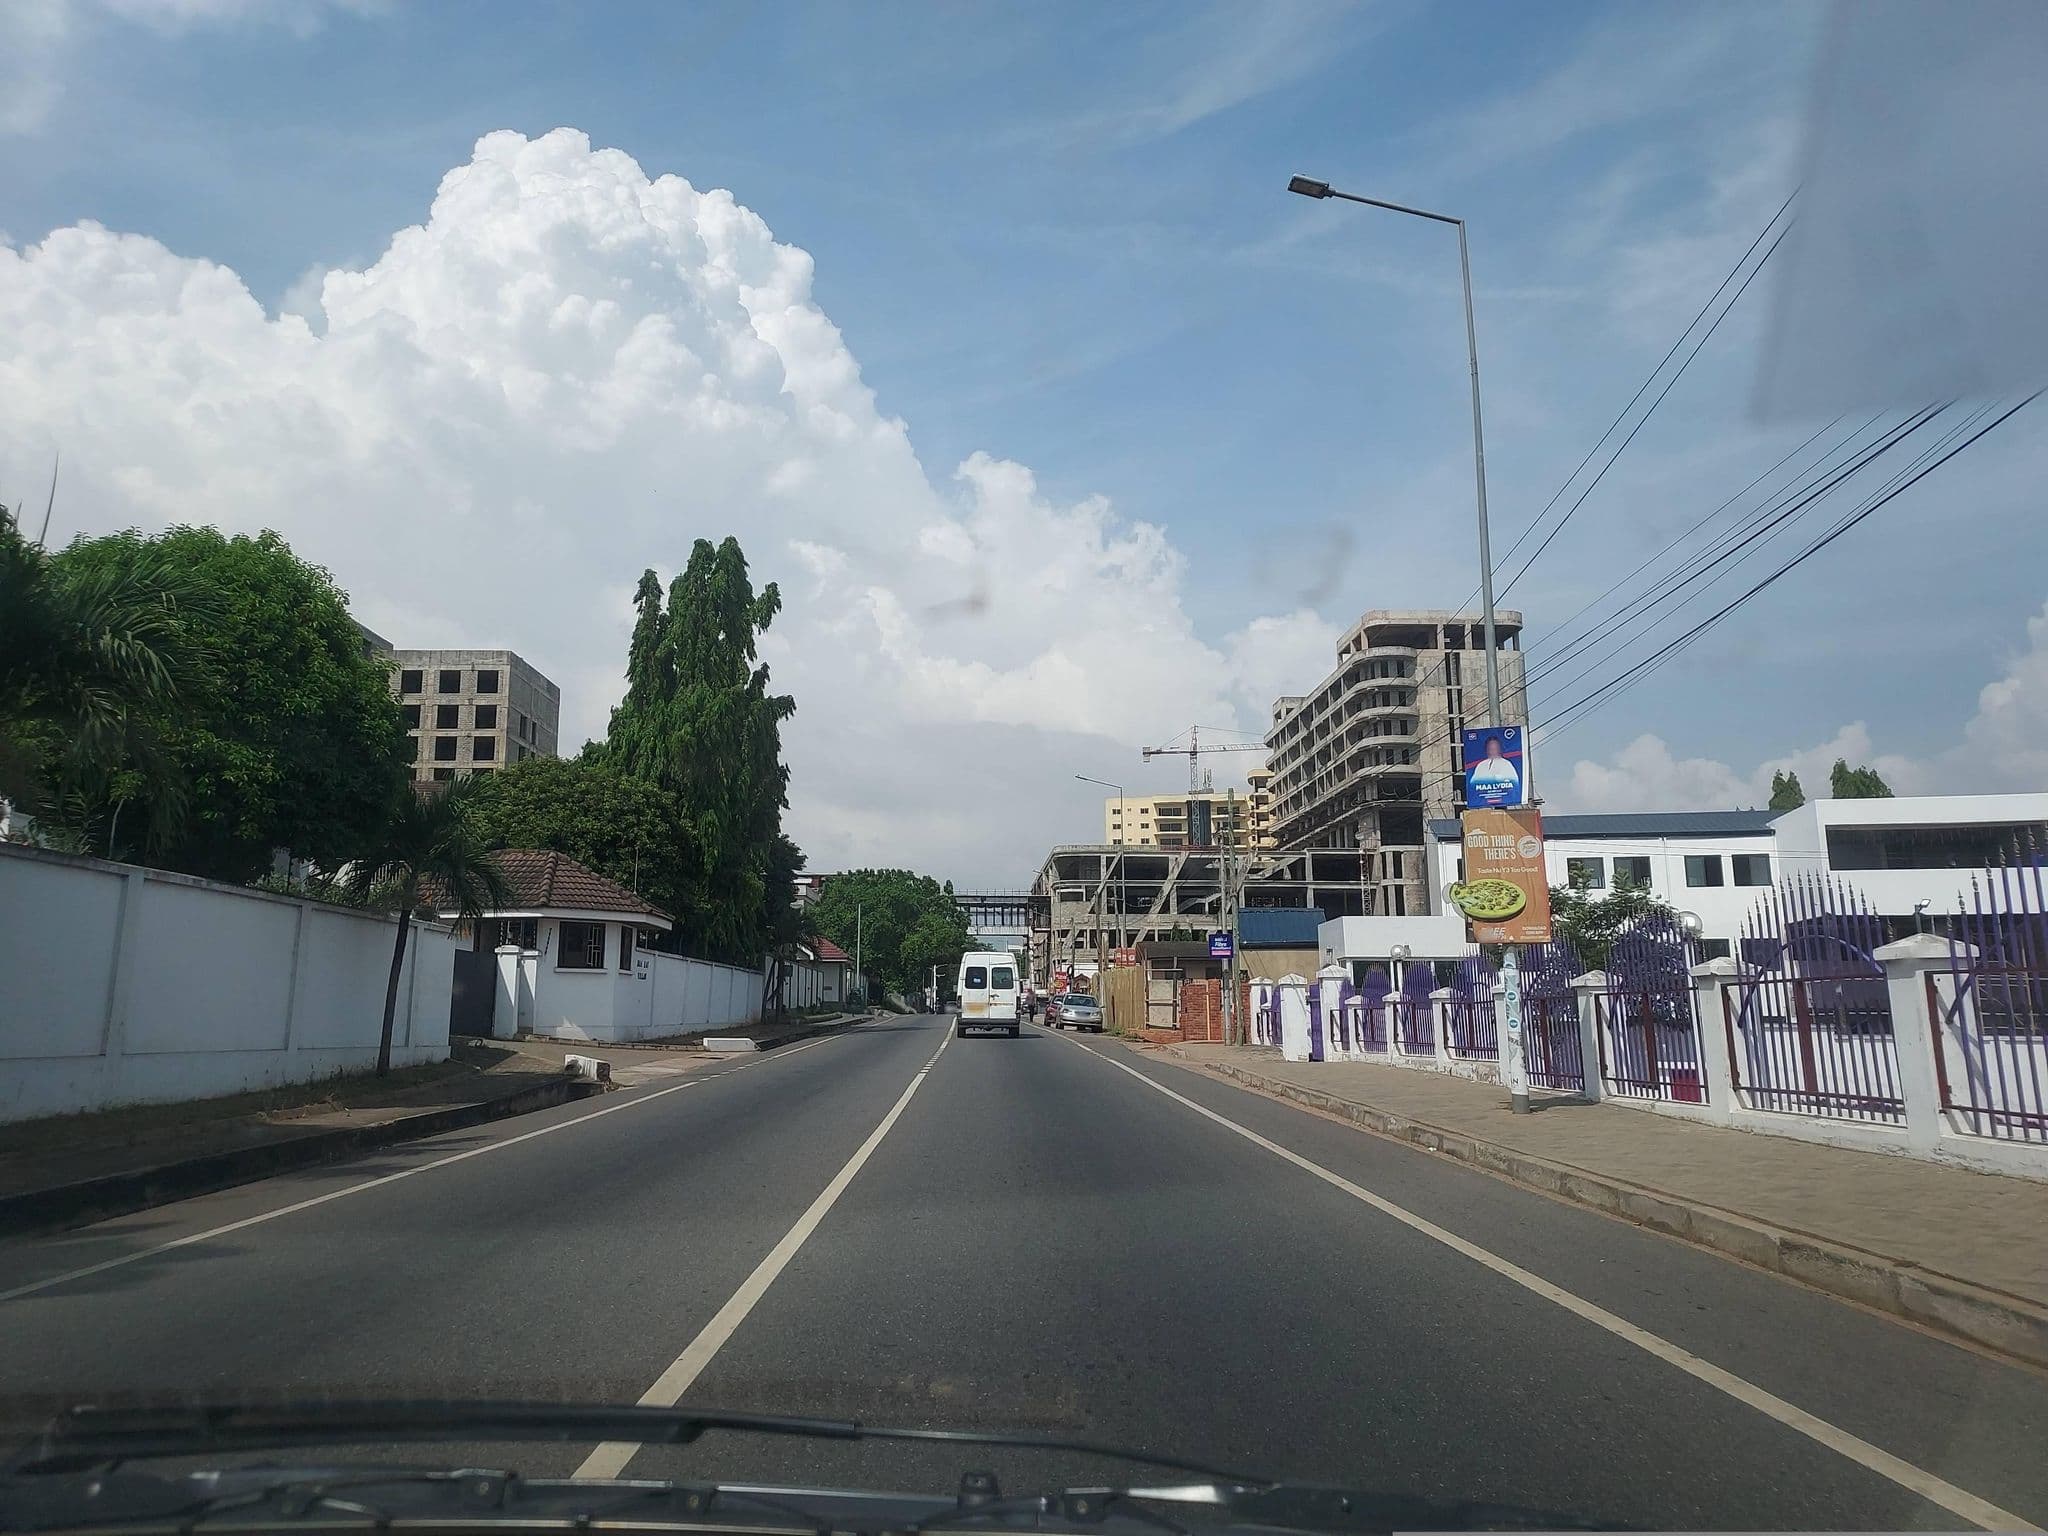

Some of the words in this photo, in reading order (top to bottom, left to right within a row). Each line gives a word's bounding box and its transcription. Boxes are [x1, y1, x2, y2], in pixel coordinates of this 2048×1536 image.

[1467, 835, 1489, 848] GOOD
[1490, 834, 1515, 847] THING
[1484, 848, 1517, 860] THERE'S
